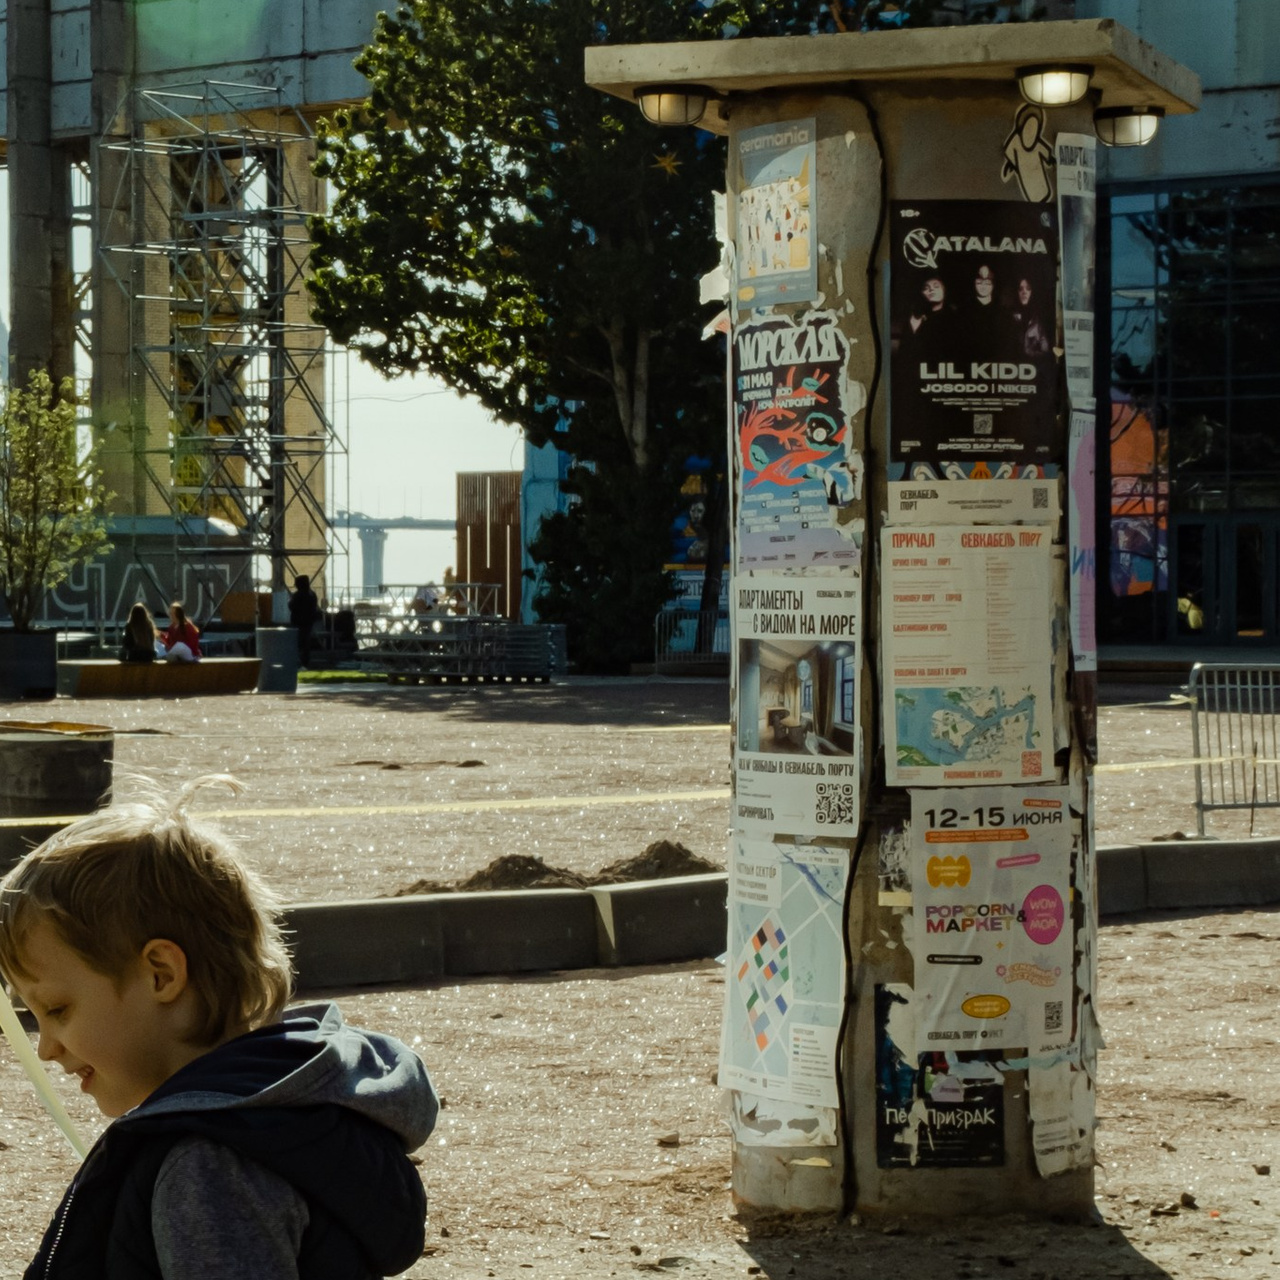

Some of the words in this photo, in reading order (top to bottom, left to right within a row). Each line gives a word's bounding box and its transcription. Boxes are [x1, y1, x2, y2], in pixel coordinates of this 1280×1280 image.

[740, 125, 809, 153] ceramania
[738, 325, 841, 371] МОРСКАЯ
[751, 371, 773, 389] МАЯ
[920, 362, 965, 379] LIL
[971, 362, 1037, 380] KIDD
[920, 384, 989, 394] JOSODO
[899, 489, 939, 500] СЕВКАБЕЛЬ
[899, 501, 918, 511] ПОРТ
[892, 533, 935, 548] ПРИЧАЛ
[961, 533, 1015, 548] СЕВКАБЕЛЬ
[1019, 532, 1043, 547] ПОРТ
[738, 589, 803, 611] АПАРТАМЕНТЫ
[753, 613, 759, 634] С
[760, 613, 797, 635] ВИДОМ
[800, 614, 816, 635] НА
[819, 614, 856, 636] МОРЕ
[784, 761, 826, 776] СЕВКАБЕЛЬ
[828, 763, 854, 777] ПОРТУ
[924, 807, 1005, 829] 12-15
[1013, 811, 1063, 826] ИЮНЯ
[925, 904, 1015, 918] POPCORN
[1016, 910, 1027, 923] &
[1029, 899, 1058, 910] WOW
[926, 916, 1014, 933] МАРКЕТ
